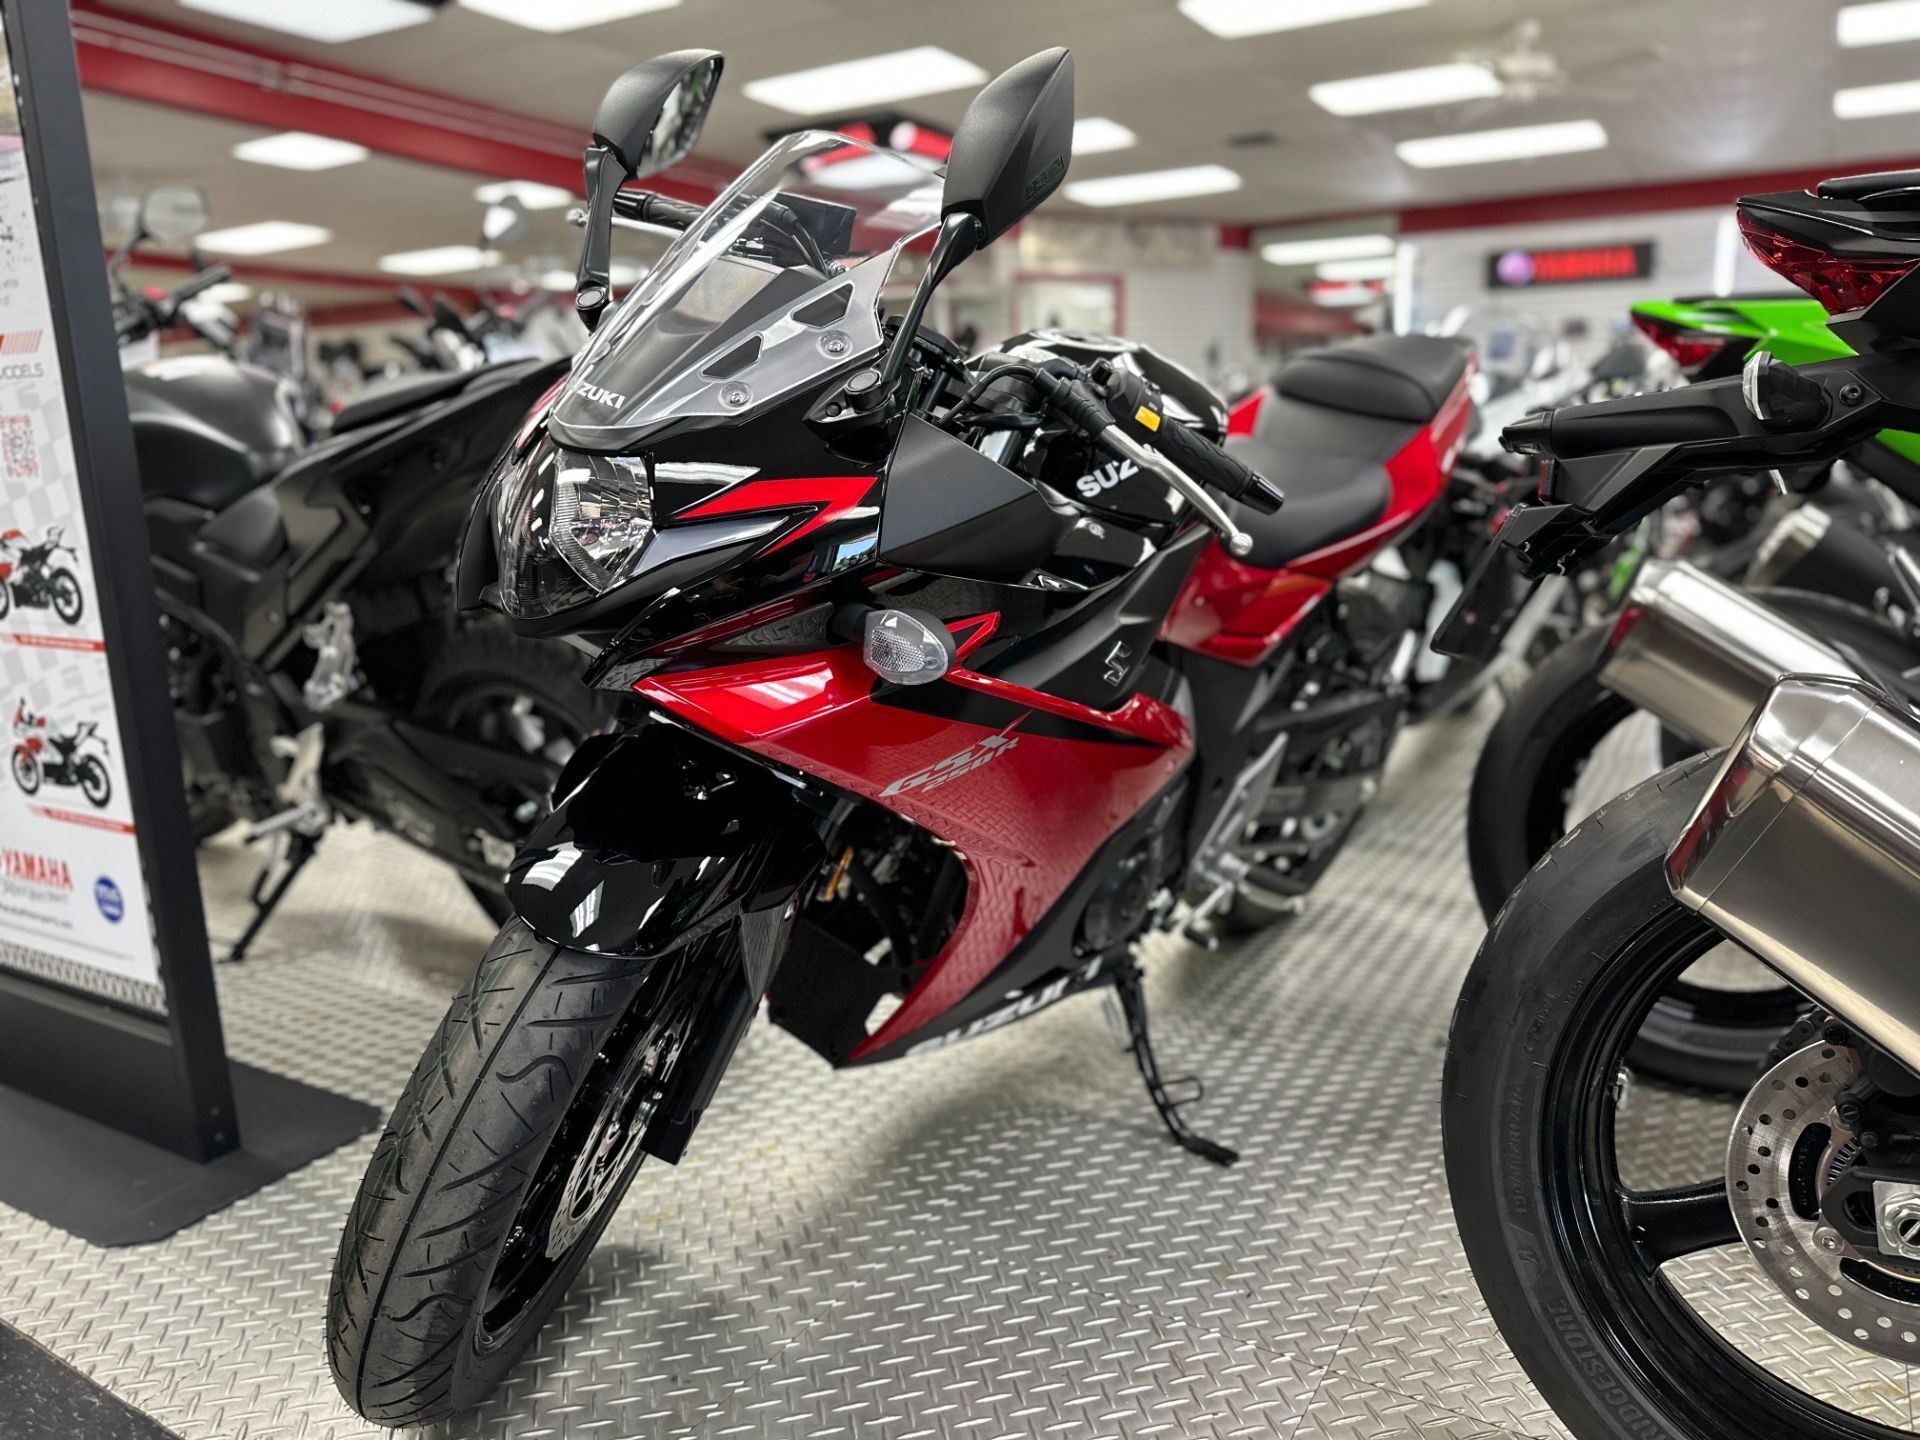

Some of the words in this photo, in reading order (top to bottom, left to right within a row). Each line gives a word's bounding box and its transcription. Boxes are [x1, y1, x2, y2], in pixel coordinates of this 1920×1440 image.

[577, 381, 626, 409] ZUKI
[1076, 458, 1140, 498] SUZ
[2, 848, 75, 892] YAMAHA
[1546, 1298, 1667, 1440] RIDGESTONE
